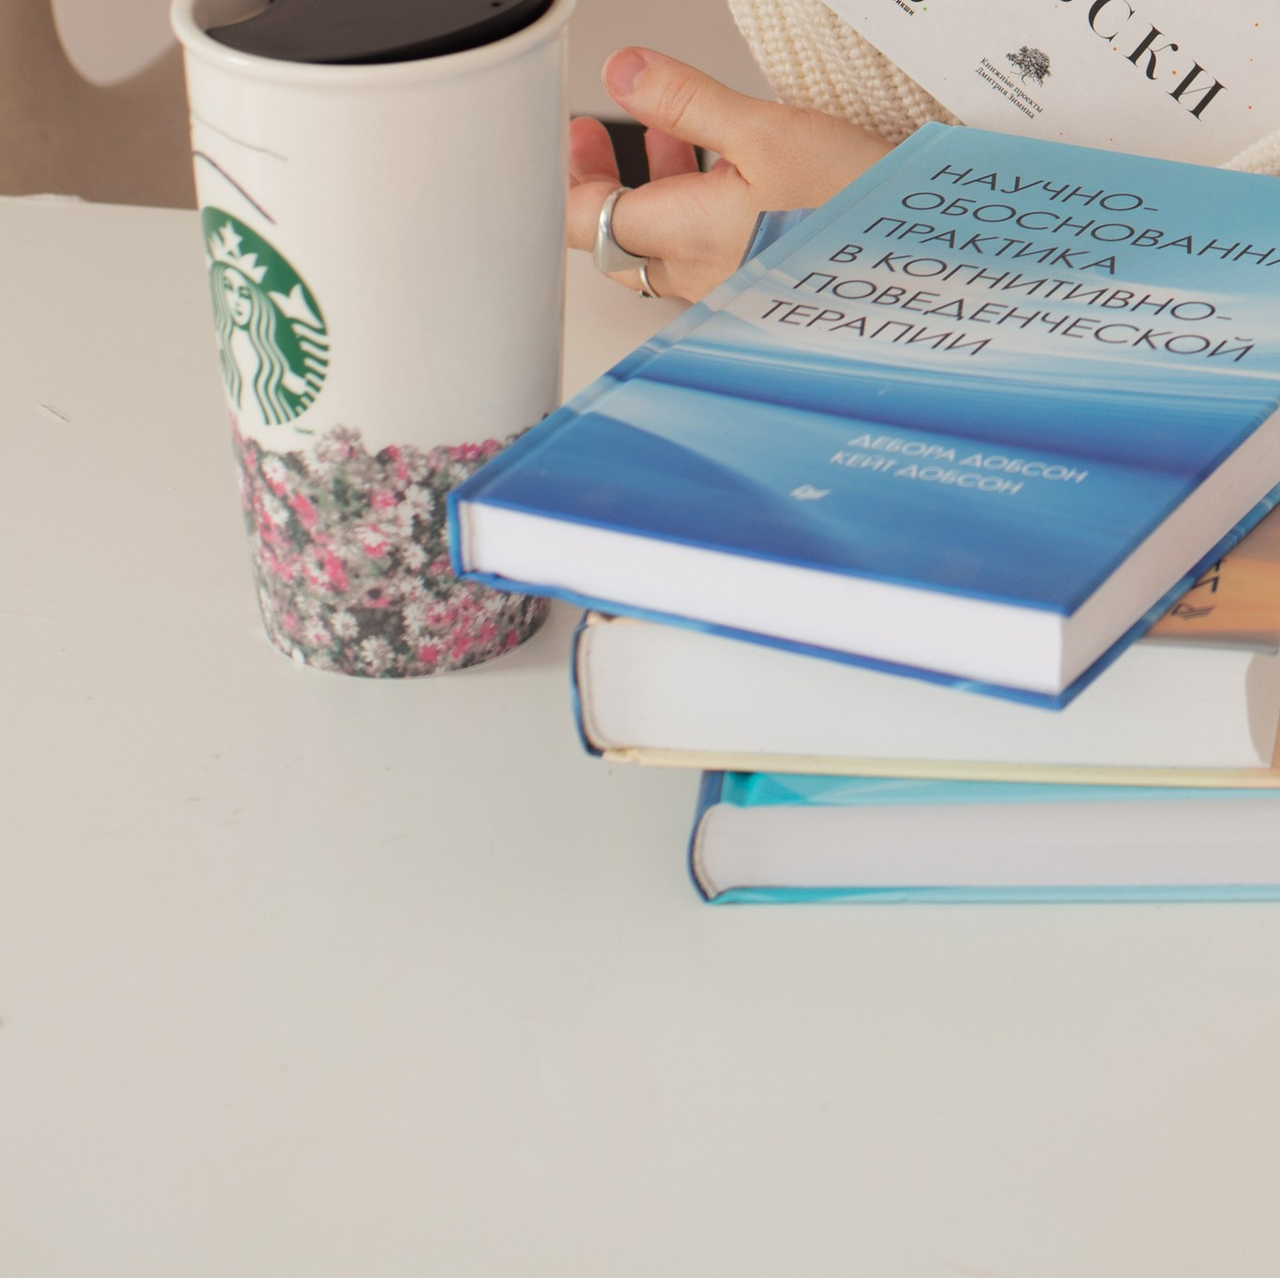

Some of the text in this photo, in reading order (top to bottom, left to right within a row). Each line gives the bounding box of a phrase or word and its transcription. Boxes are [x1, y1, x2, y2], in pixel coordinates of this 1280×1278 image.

[975, 66, 1035, 119] Дмитрия Зимина
[980, 57, 1043, 114] Книжные проекты
[929, 164, 1159, 212] НАУЧНО-
[862, 216, 1116, 275] ПРАКТИКА
[828, 243, 1233, 321] В КОГНИТИВНО-
[760, 299, 994, 357] ТЕРАПИИ
[792, 271, 1256, 363] ПОВЕДЕНЧЕСКОЙ
[829, 450, 1025, 496] КЕЙТ ДОБСОН
[847, 433, 1090, 485] ДЕБОРА ДОБСОН
